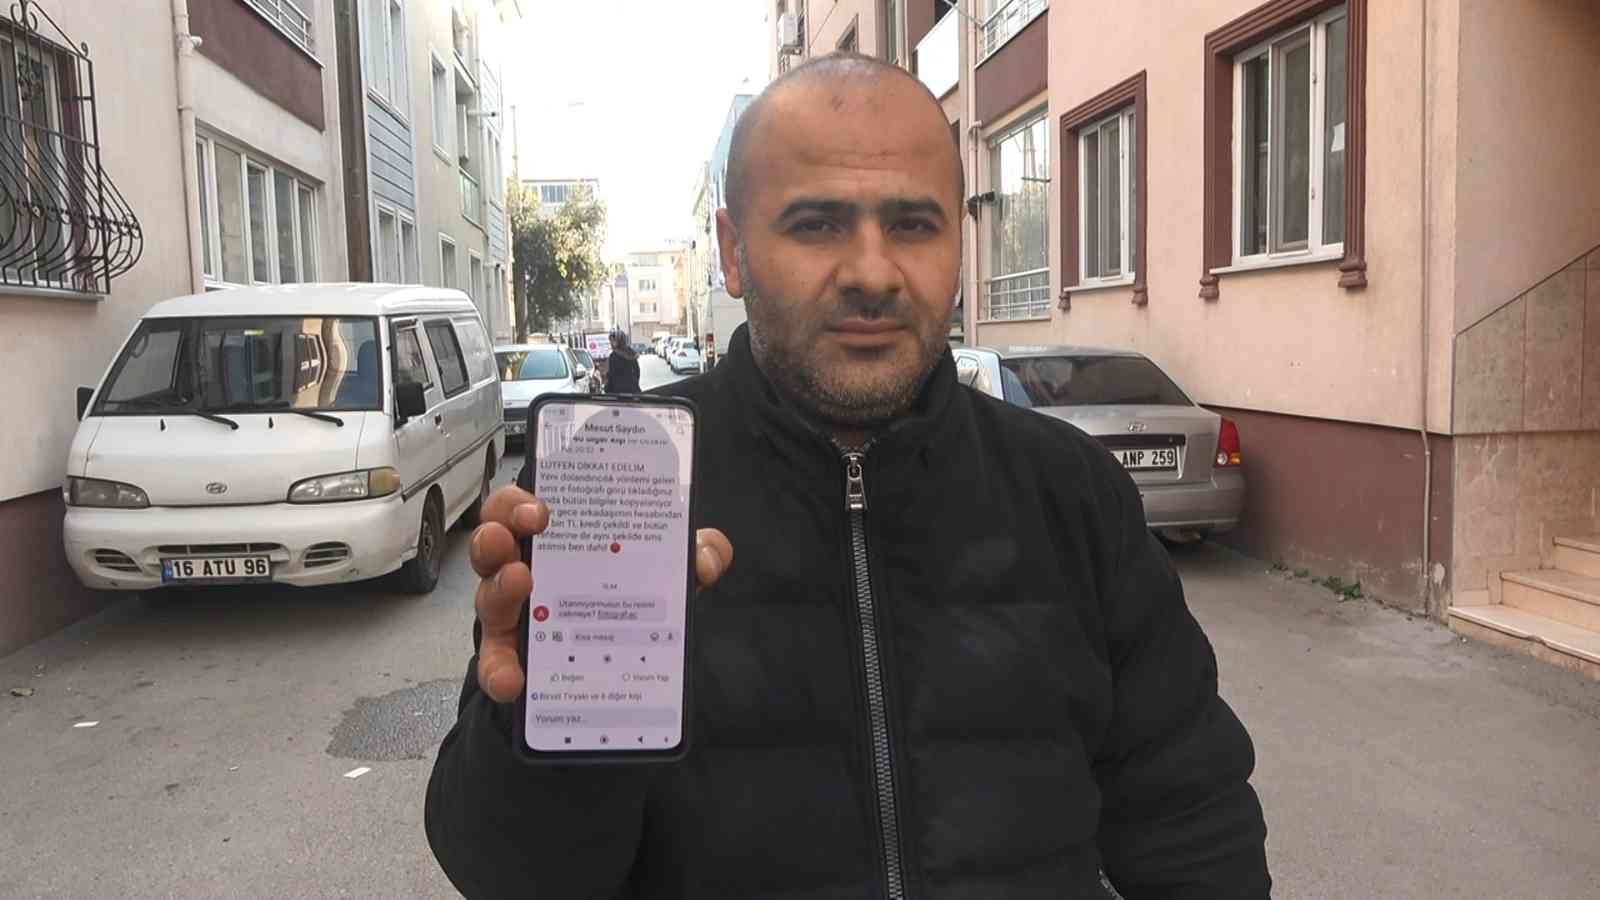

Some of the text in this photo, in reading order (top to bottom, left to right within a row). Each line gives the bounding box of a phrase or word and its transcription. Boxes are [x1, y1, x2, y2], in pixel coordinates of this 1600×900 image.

[585, 424, 614, 433] Mesut
[1122, 451, 1175, 466] ANP 259
[557, 509, 578, 518] gece
[580, 519, 601, 528] kredi
[568, 543, 584, 552] ben
[174, 561, 194, 577] 16
[203, 560, 236, 577] ATU
[244, 559, 267, 575] 96
[535, 714, 564, 724] Yorum
